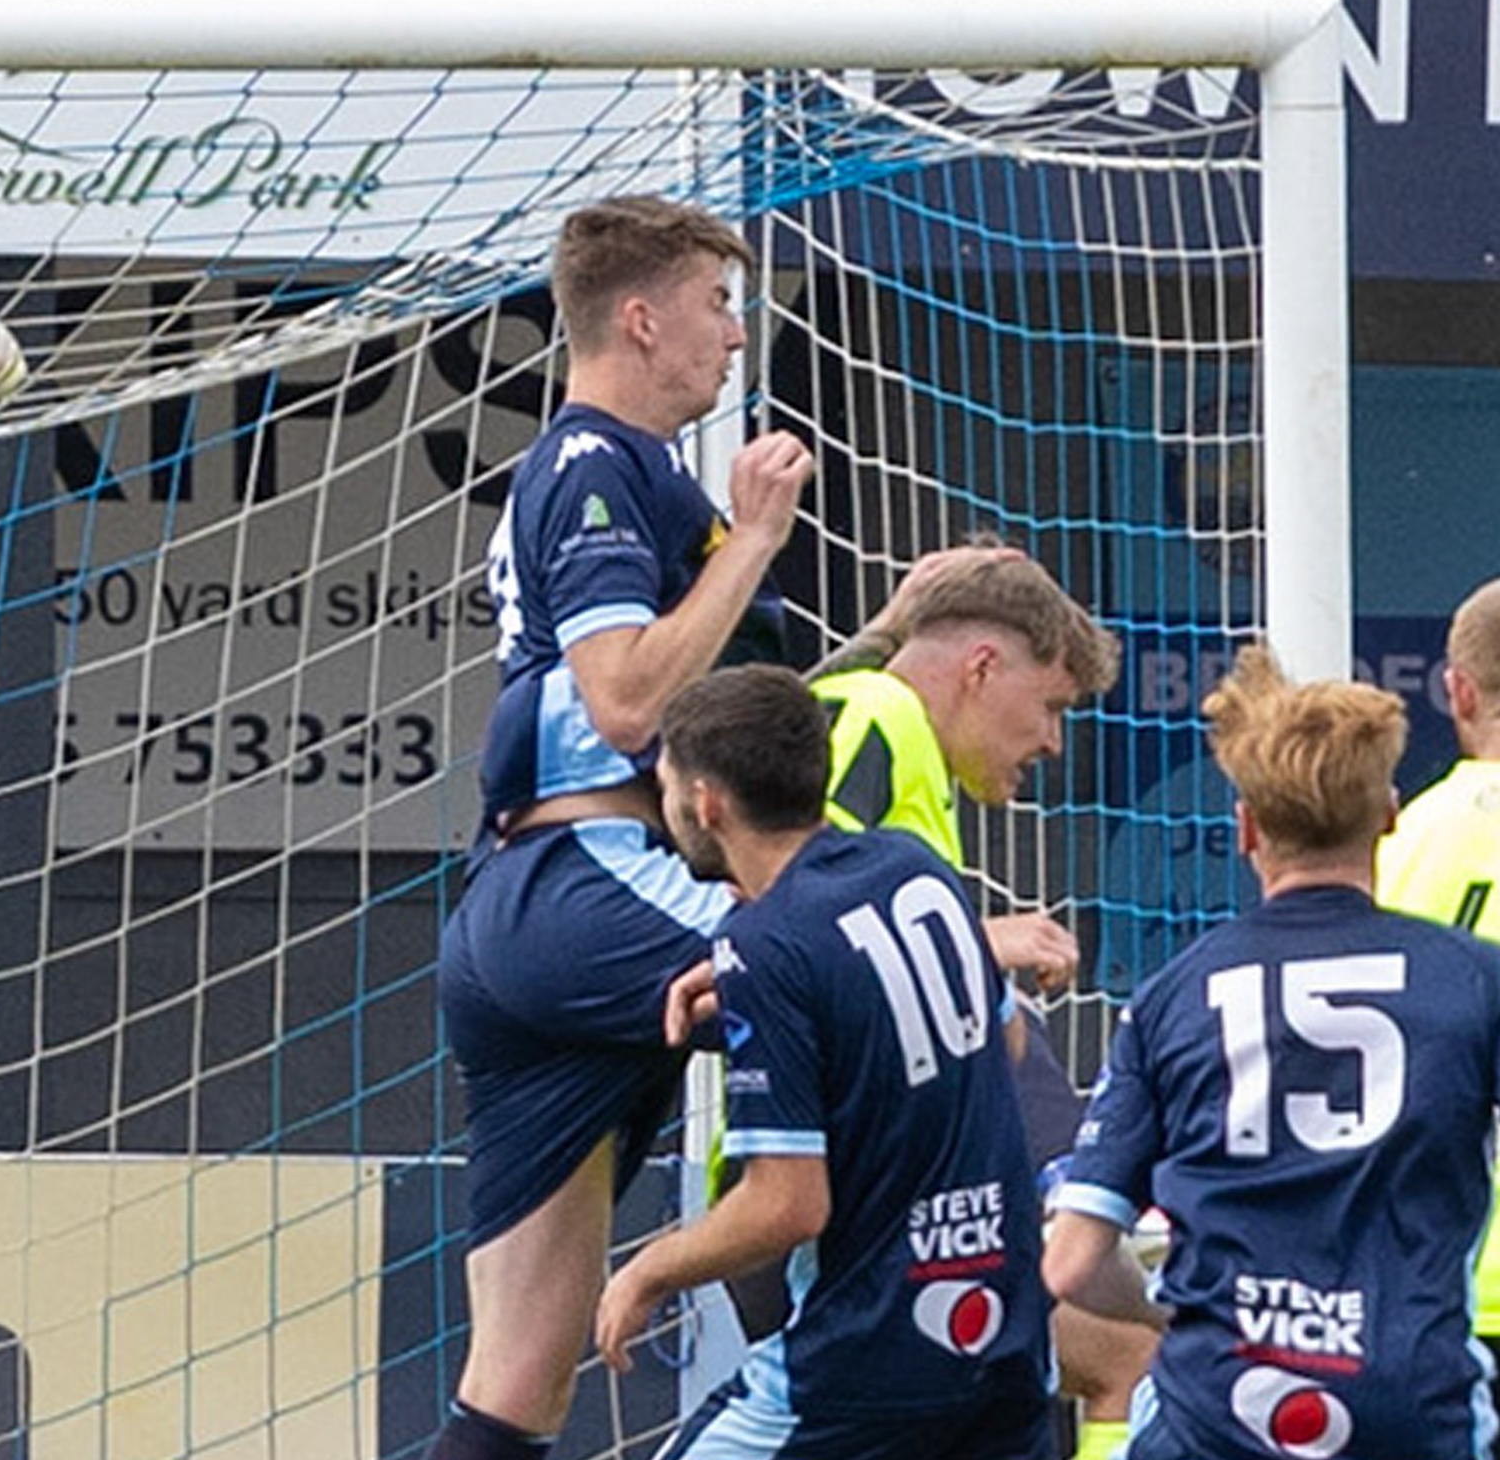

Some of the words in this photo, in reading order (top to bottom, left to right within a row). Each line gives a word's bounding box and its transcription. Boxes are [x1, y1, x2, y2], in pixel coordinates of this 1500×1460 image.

[177, 115, 384, 211] Park
[161, 570, 302, 640] yard
[326, 570, 500, 641] skips
[114, 712, 440, 787] 753333
[837, 875, 989, 1088] 10
[1206, 953, 1406, 1157] 15
[908, 1182, 1003, 1229] STEVE
[908, 1215, 1005, 1263] VICK
[1234, 1274, 1365, 1321] STEVE
[1234, 1305, 1365, 1357] VICK
